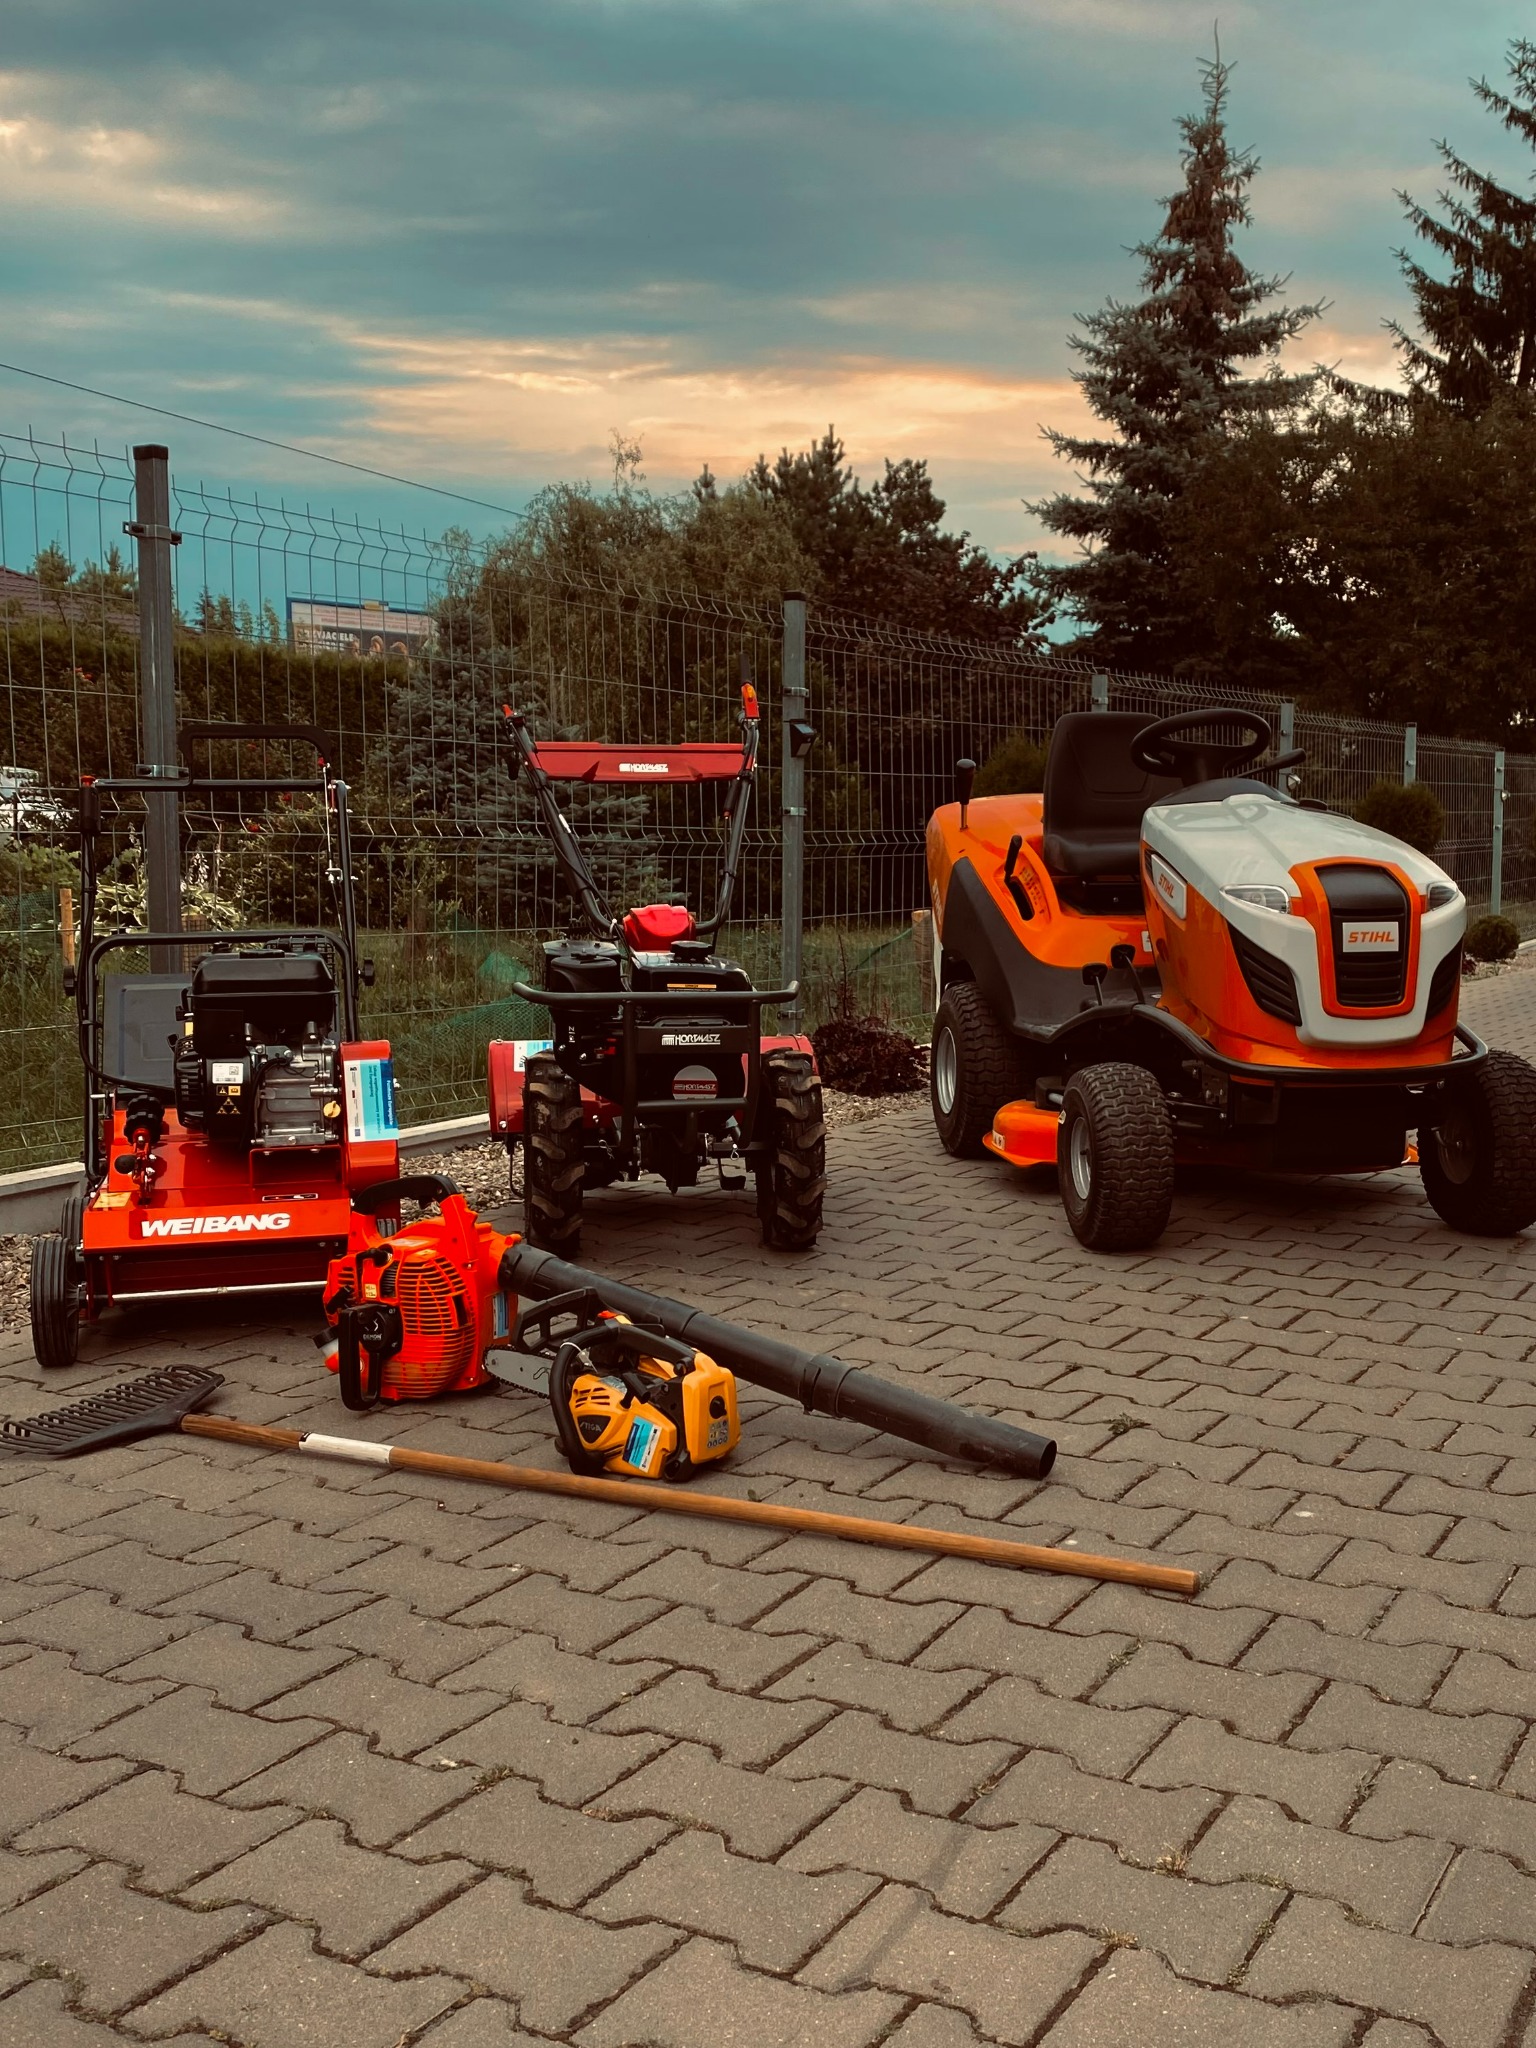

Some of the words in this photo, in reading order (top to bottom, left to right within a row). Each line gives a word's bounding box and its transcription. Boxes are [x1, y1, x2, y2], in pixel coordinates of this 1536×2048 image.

[1158, 873, 1174, 899] STIHL
[1347, 931, 1395, 943] STIHL
[674, 1034, 721, 1046] HORTMASZ
[141, 1213, 291, 1237] WEIBANG
